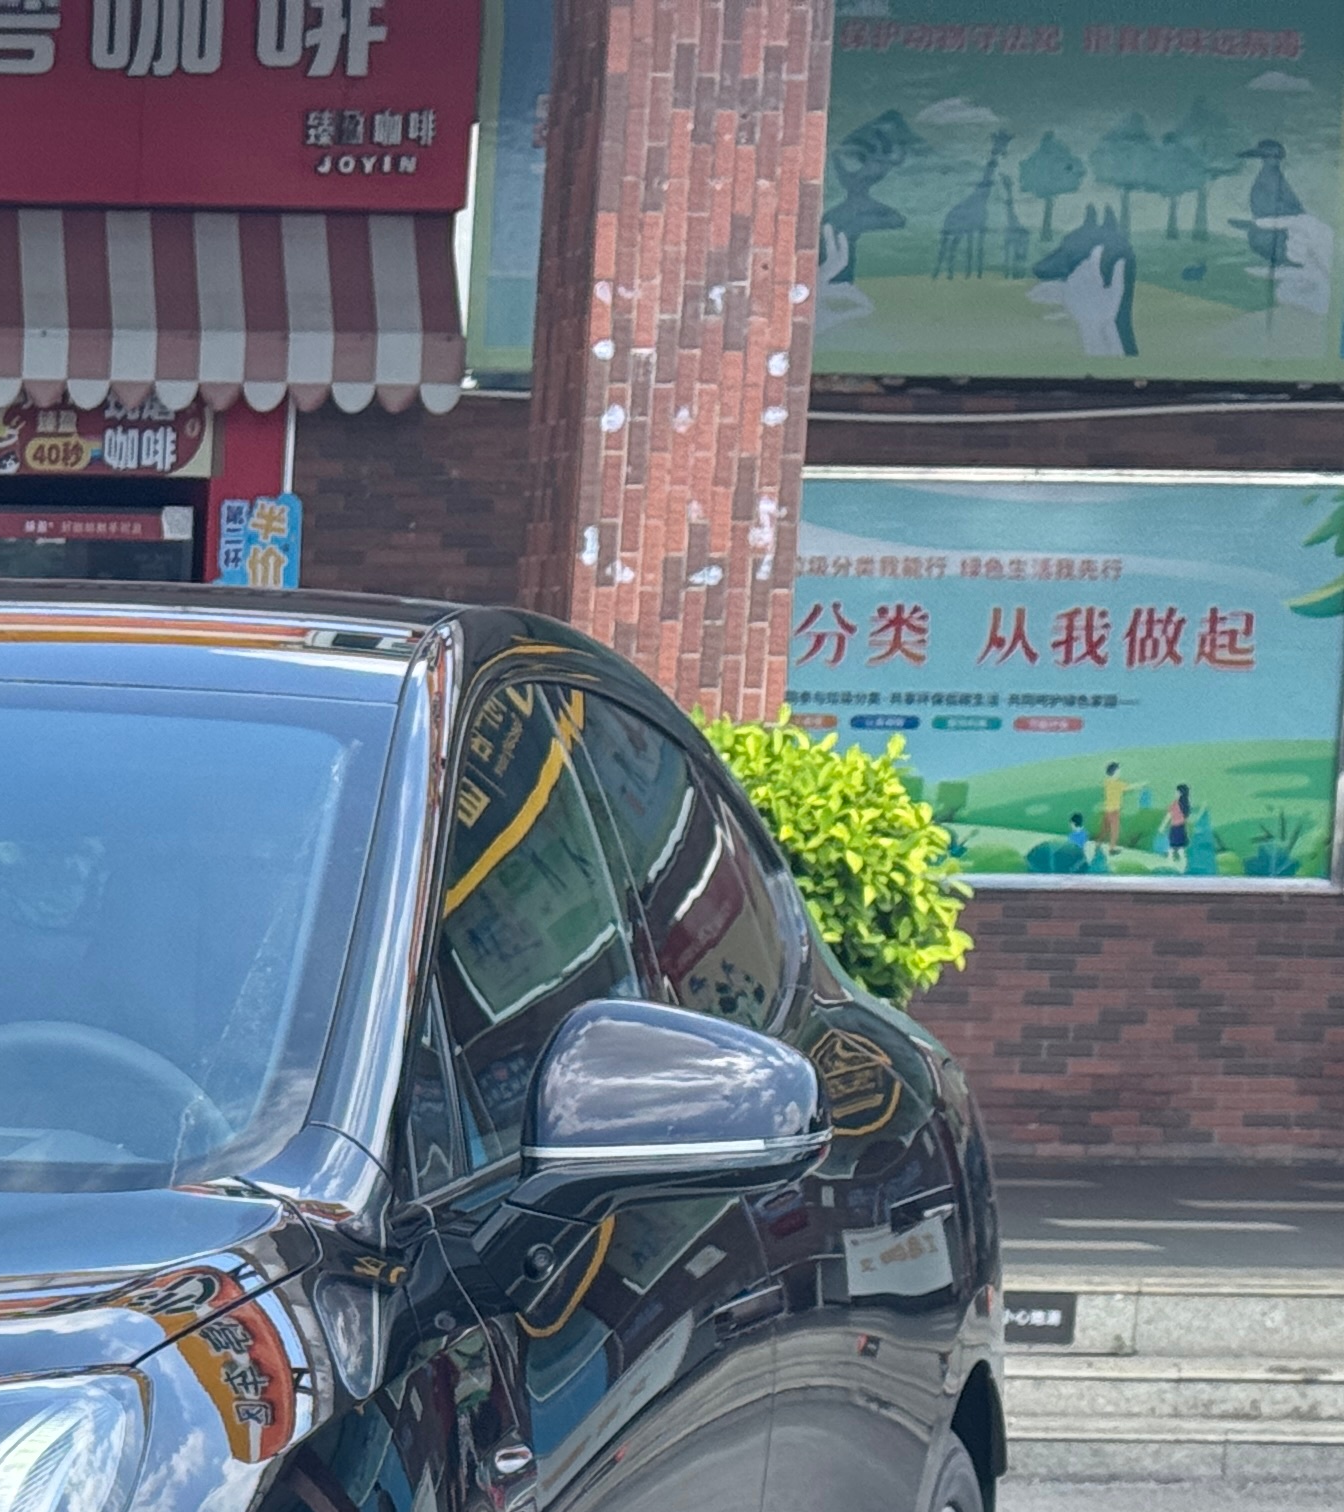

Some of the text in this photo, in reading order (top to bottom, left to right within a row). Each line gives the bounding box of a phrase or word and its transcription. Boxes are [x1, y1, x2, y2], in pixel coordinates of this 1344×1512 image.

[316, 155, 417, 174] JOYIN
[32, 443, 84, 467] 40秒
[105, 426, 176, 471] 咖啡
[249, 502, 287, 588] 半价
[794, 602, 1256, 671] 分类 从我做起
